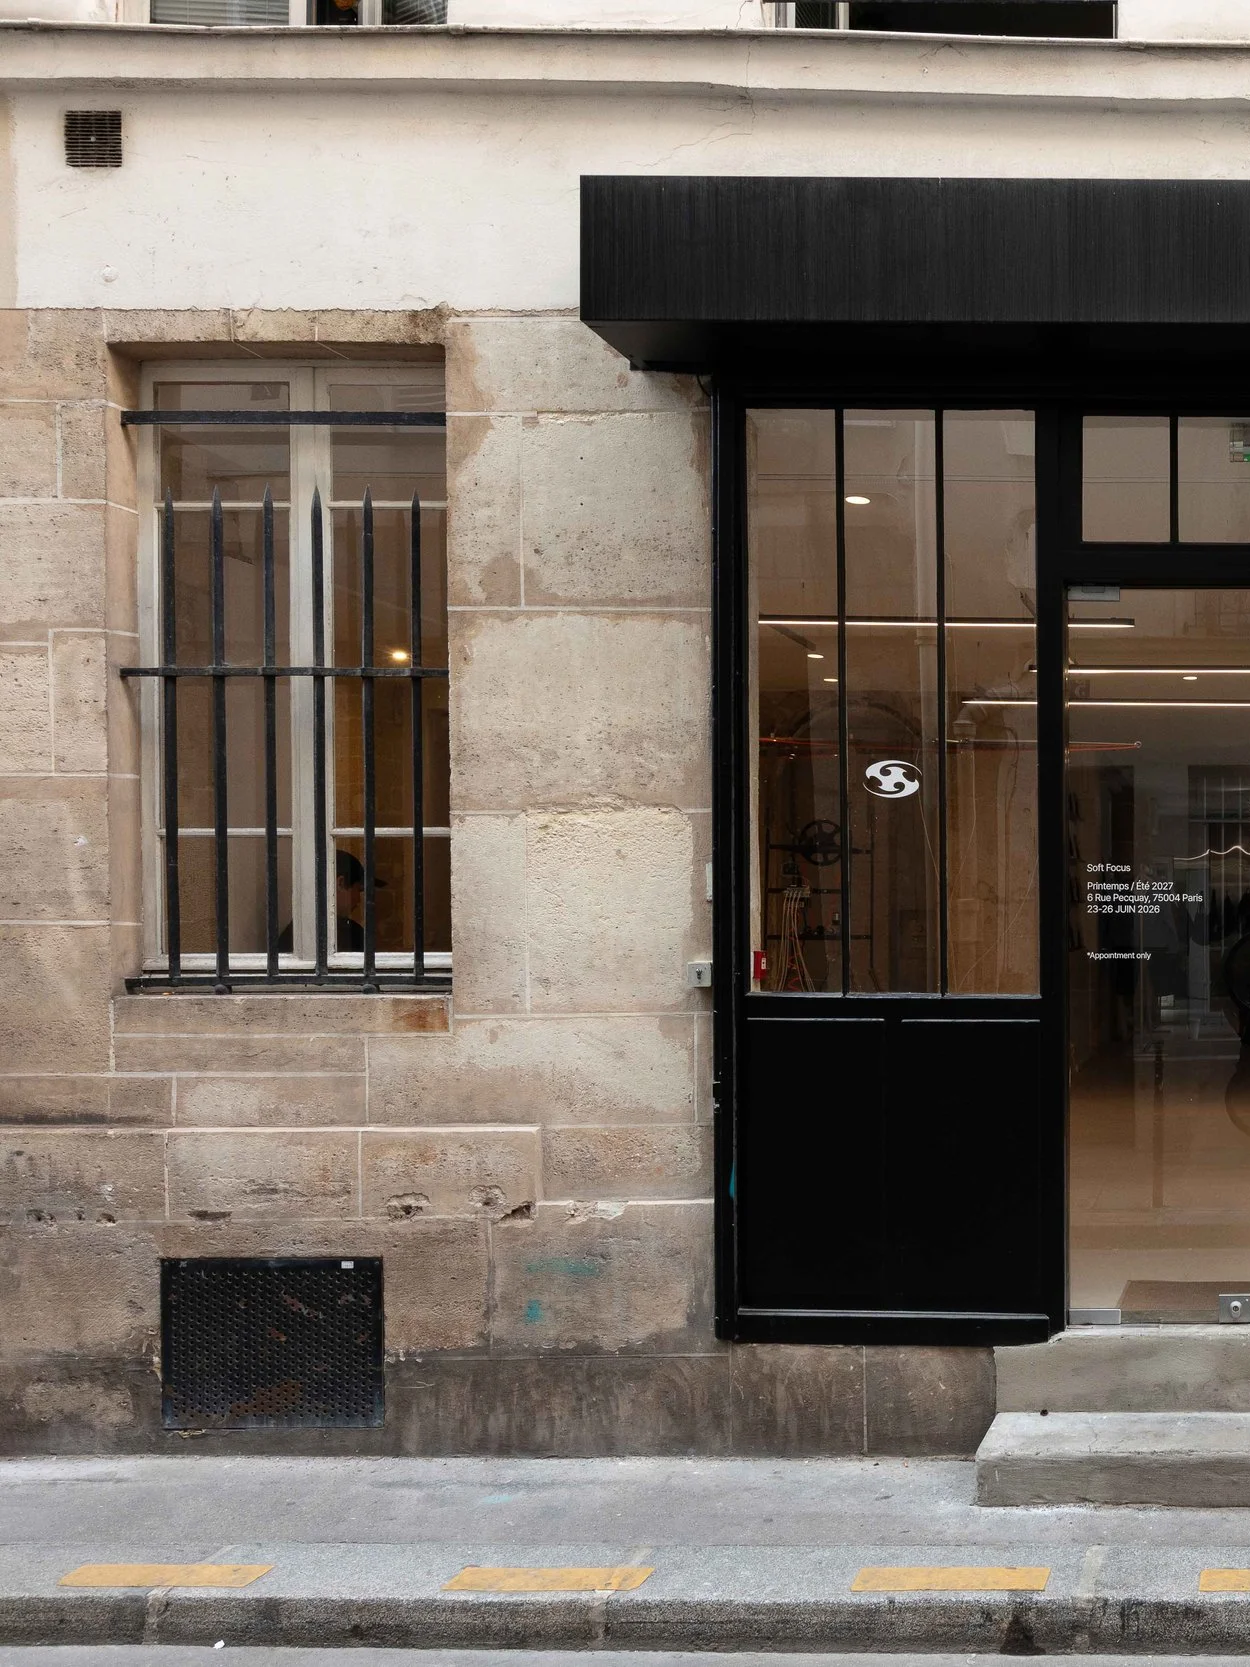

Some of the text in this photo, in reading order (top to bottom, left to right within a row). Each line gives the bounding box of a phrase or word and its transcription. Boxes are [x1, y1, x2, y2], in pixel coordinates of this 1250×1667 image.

[1087, 864, 1131, 872] Soft Focus
[1087, 882, 1129, 892] Printemps
[1136, 880, 1150, 891] Été
[1151, 882, 1174, 891] 2027
[1087, 893, 1203, 904] 6 Rue Pecquay, 75004 Paris
[1087, 905, 1160, 914] 23-26 JUIN 2026
[1136, 952, 1152, 961] only
